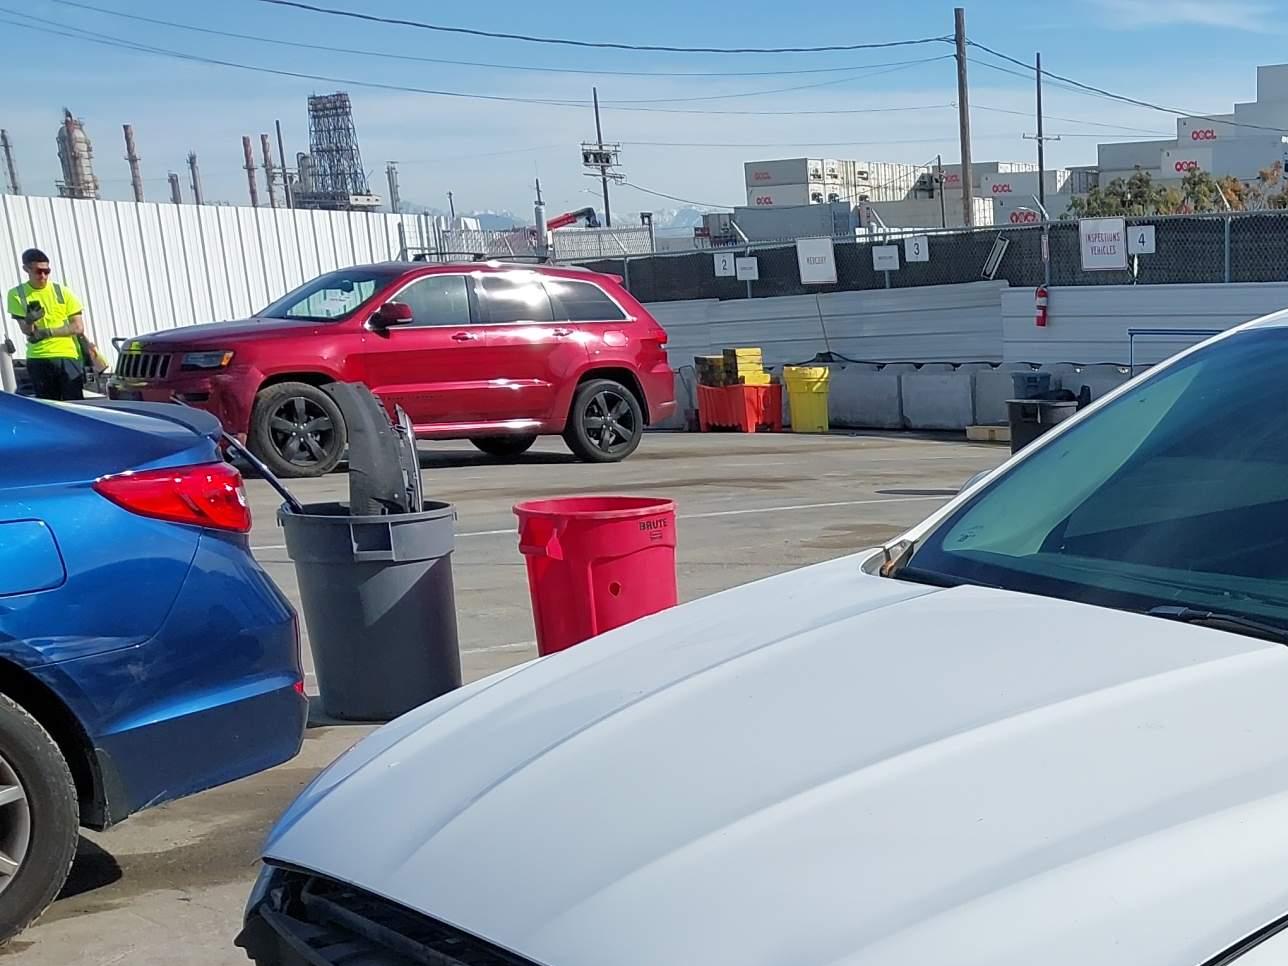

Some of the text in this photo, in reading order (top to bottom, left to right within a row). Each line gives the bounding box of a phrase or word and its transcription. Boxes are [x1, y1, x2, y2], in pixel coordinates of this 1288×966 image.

[1086, 231, 1121, 243] INSPECTIONS
[1137, 232, 1147, 247] 4
[913, 242, 921, 256] 3
[1090, 245, 1117, 256] VEHICLES
[721, 259, 728, 271] 2
[640, 517, 668, 531] BRUTE
